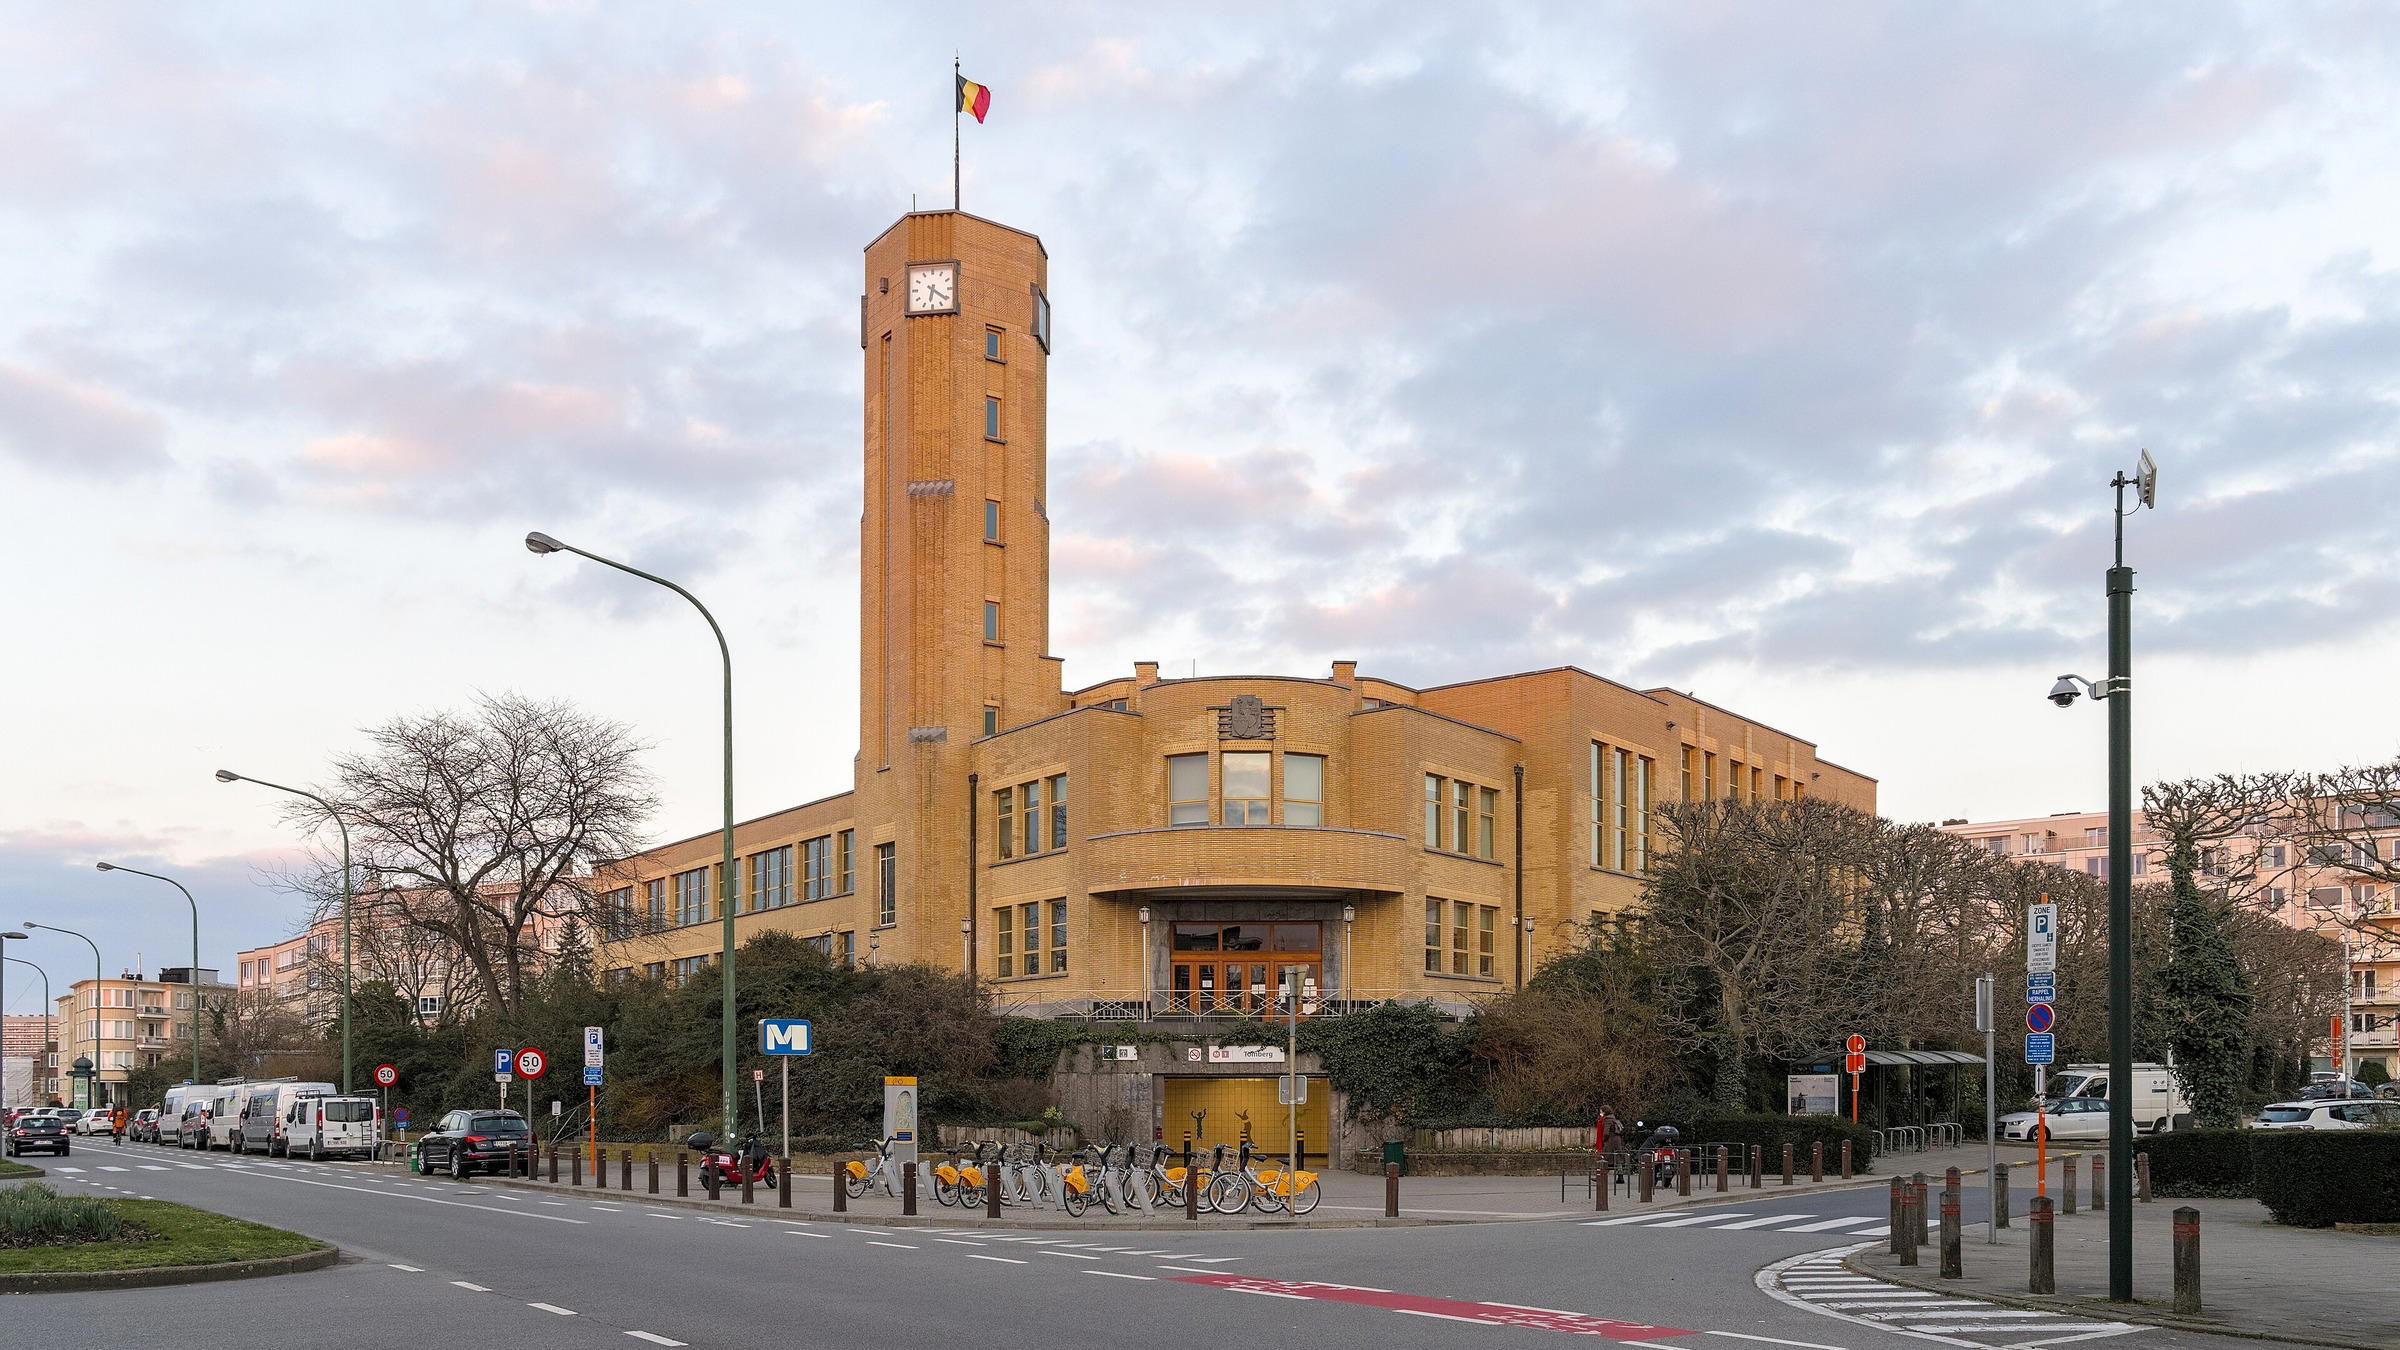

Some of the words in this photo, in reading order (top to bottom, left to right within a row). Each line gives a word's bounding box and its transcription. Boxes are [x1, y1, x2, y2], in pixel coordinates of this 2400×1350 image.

[2037, 916, 2047, 932] P
[767, 1024, 807, 1050] M
[1243, 1050, 1273, 1058] Tomberg
[498, 1053, 510, 1069] P
[522, 1057, 539, 1067] 50
[380, 1070, 393, 1078] 50
